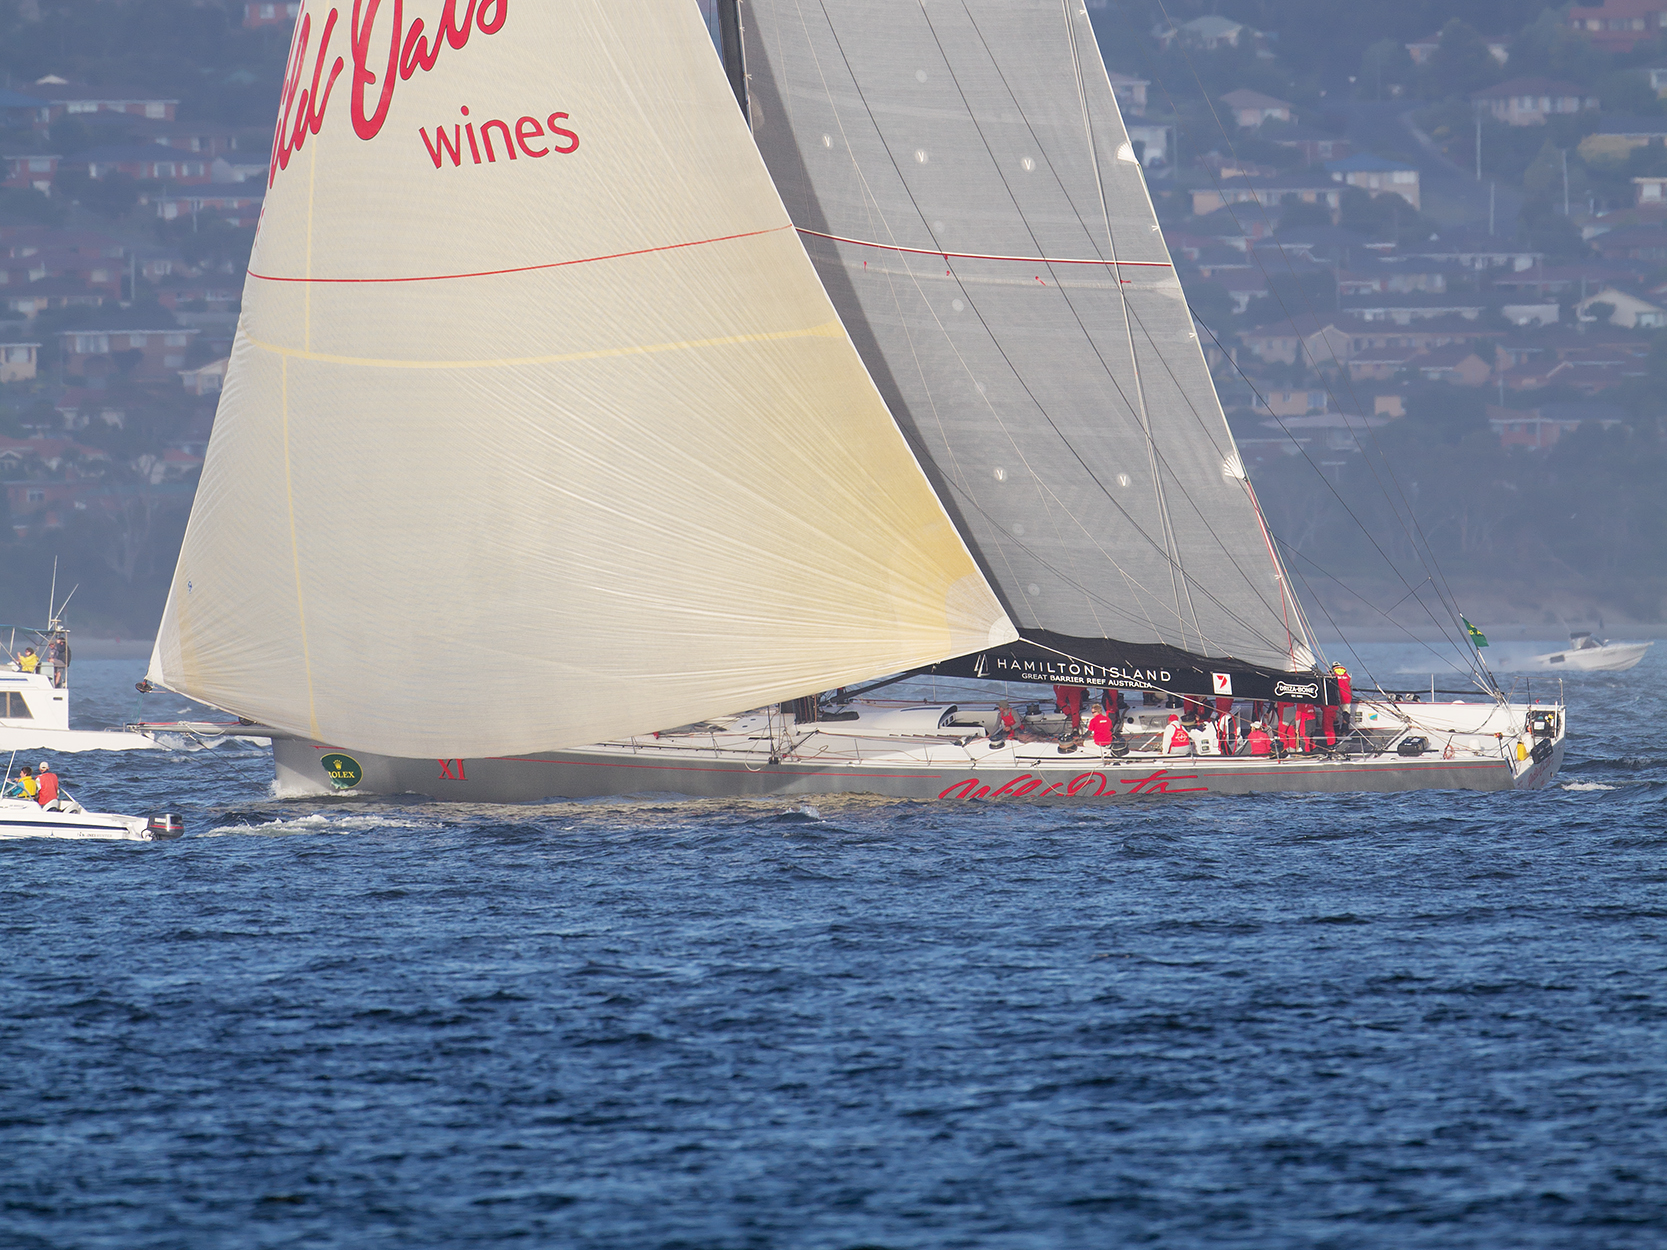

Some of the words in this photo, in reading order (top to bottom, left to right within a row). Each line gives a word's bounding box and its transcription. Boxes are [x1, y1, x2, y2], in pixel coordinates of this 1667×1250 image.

[419, 105, 580, 170] wines
[997, 658, 1095, 676] HAMILTON
[1102, 666, 1171, 682] ISLAND
[1021, 673, 1048, 681] GREAT
[1050, 674, 1085, 684] BARRIER
[1086, 677, 1106, 685] REEF
[1108, 679, 1153, 689] AUSTRALIA
[437, 758, 468, 781] XI
